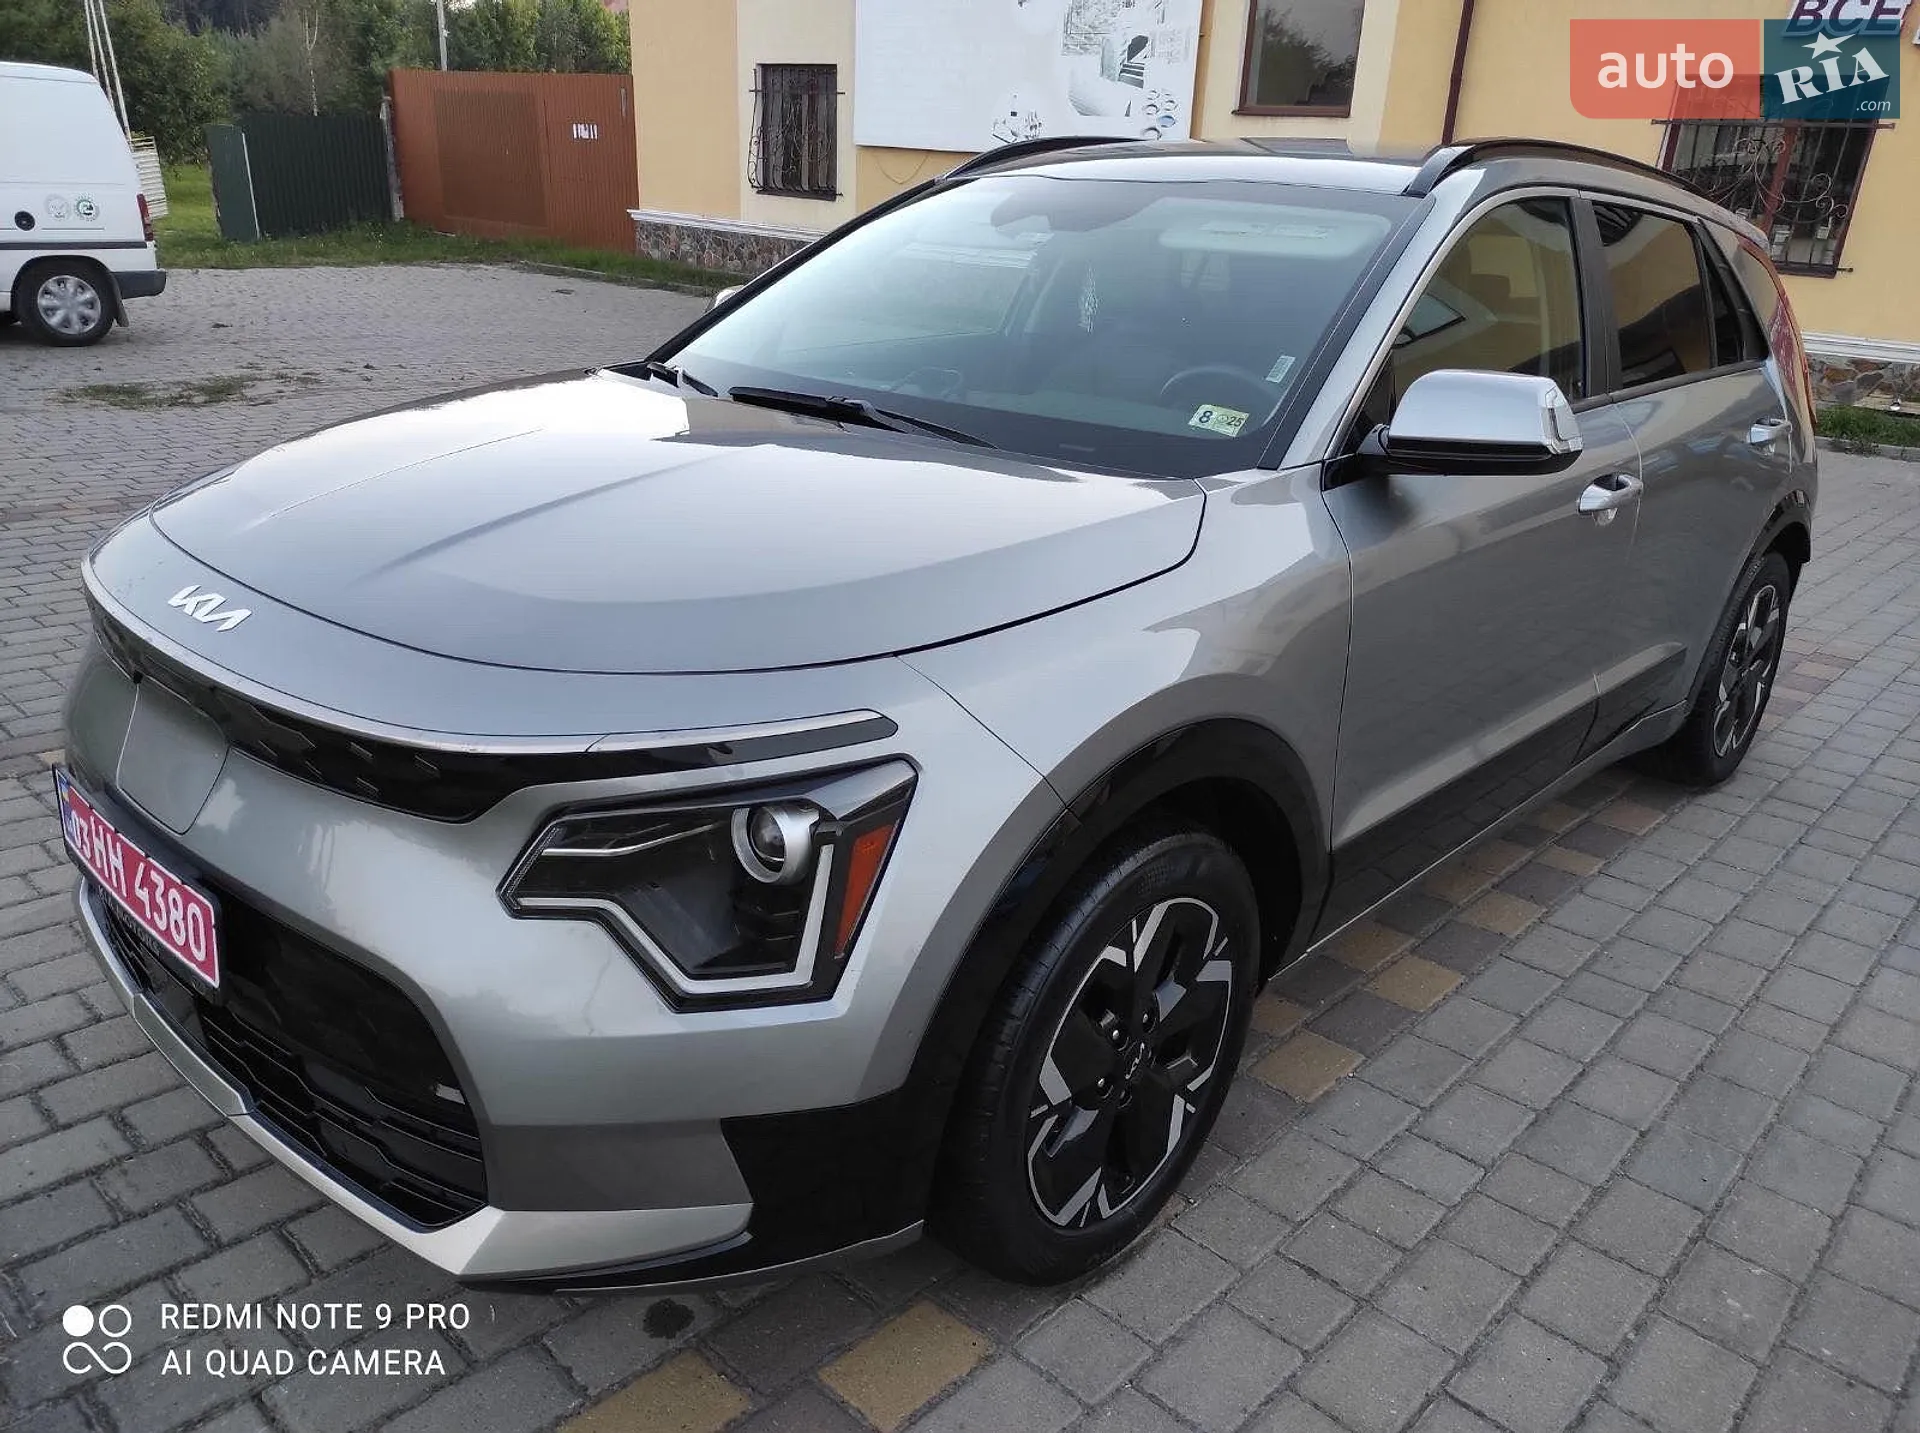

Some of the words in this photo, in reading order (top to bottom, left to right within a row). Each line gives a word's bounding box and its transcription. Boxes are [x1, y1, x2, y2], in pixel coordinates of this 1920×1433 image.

[1199, 410, 1213, 424] 8
[1226, 416, 1244, 427] 25
[167, 584, 252, 633] KIA
[134, 862, 207, 961] 4380
